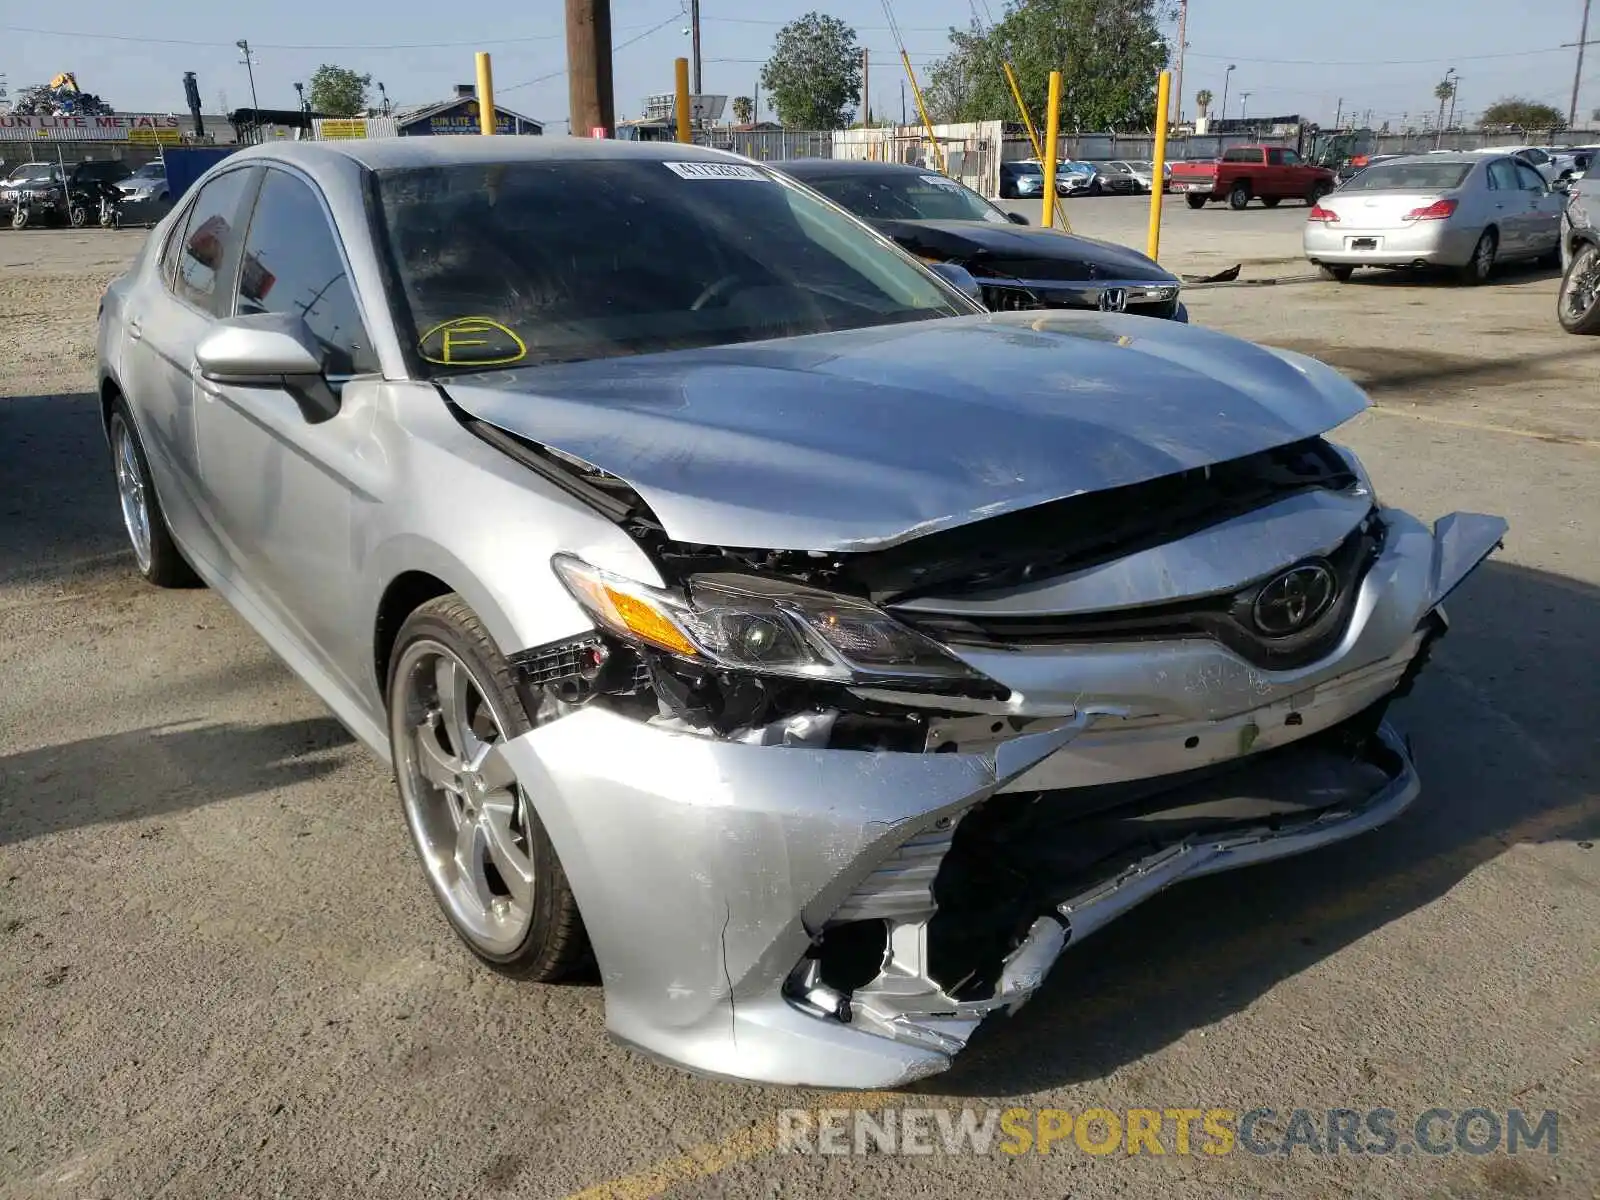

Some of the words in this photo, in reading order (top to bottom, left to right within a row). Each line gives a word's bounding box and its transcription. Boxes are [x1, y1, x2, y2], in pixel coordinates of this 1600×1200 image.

[40, 116, 86, 128] LITE
[95, 116, 179, 128] METALS
[431, 117, 449, 127] SUN
[450, 117, 470, 127] LITE
